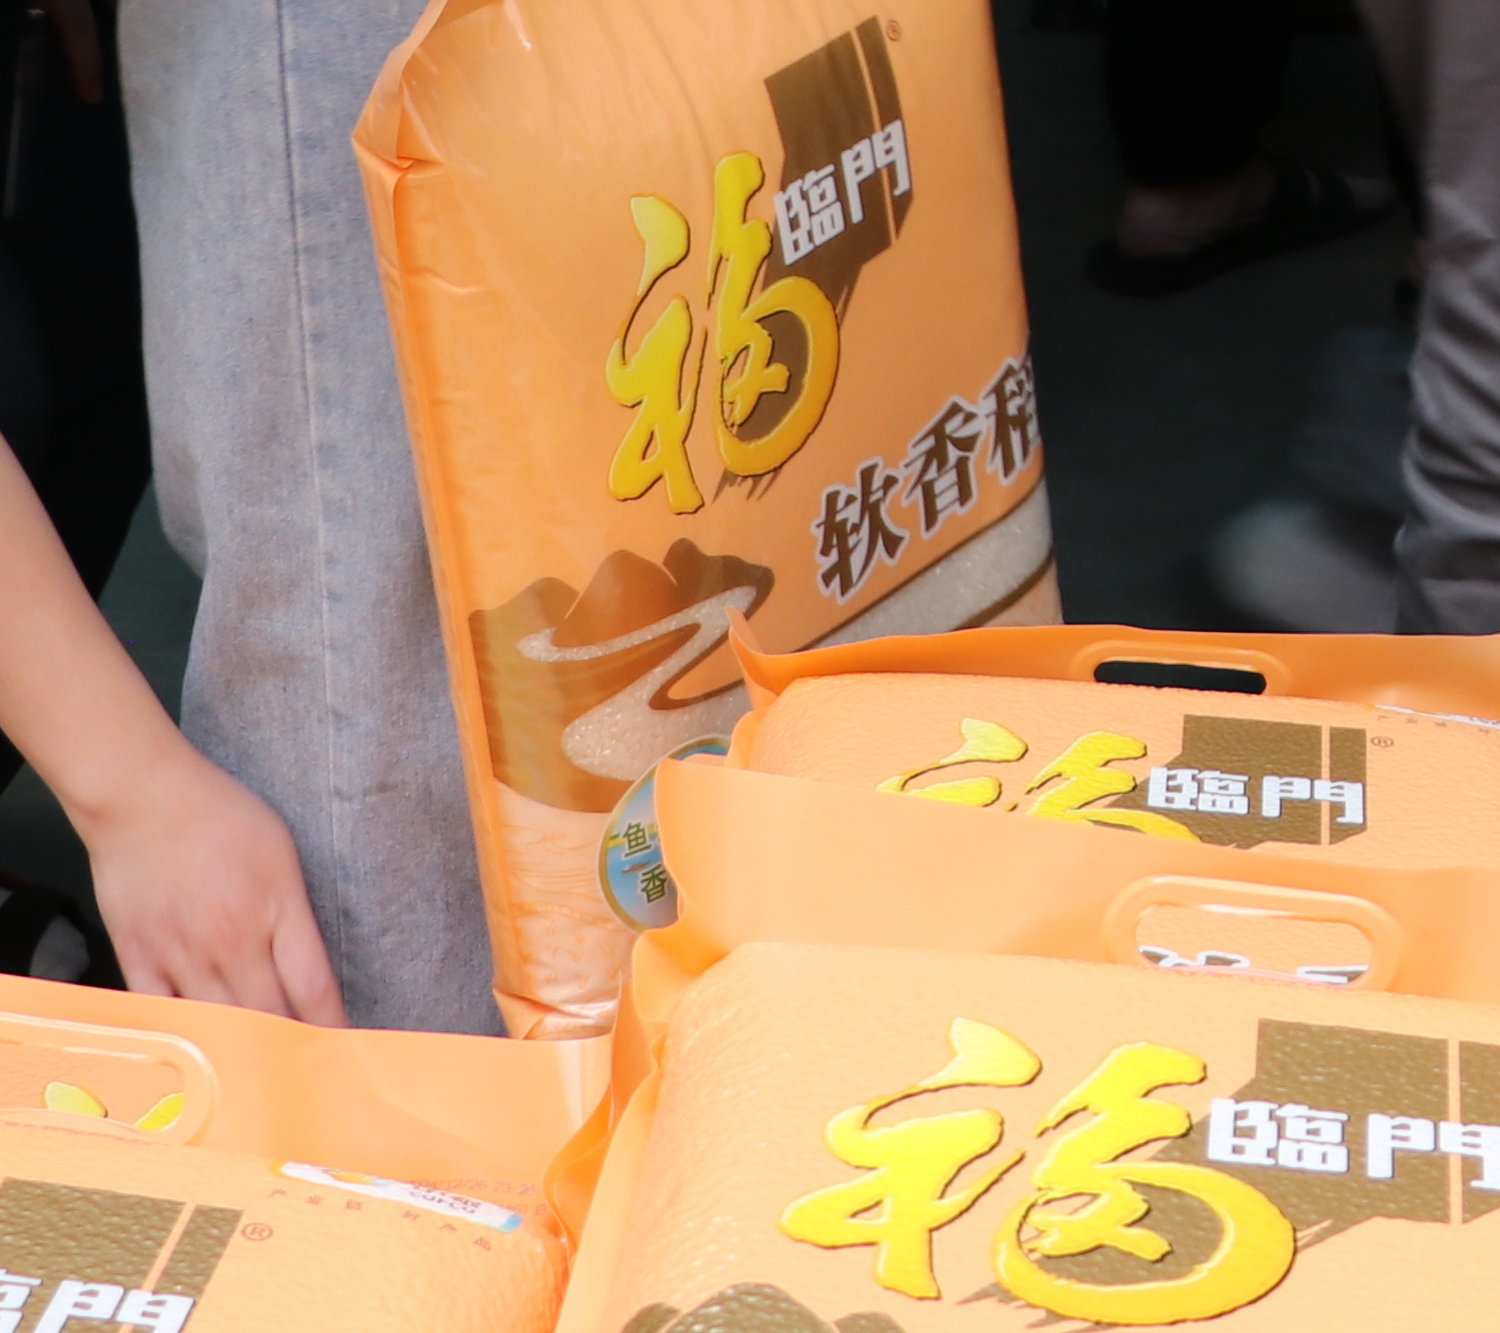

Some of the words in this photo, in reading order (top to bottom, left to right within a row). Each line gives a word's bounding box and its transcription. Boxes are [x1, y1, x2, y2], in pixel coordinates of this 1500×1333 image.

[604, 150, 841, 515] 福
[772, 119, 913, 266] 臨門
[1146, 765, 1365, 825] 臨門
[776, 1017, 1297, 1324] 福
